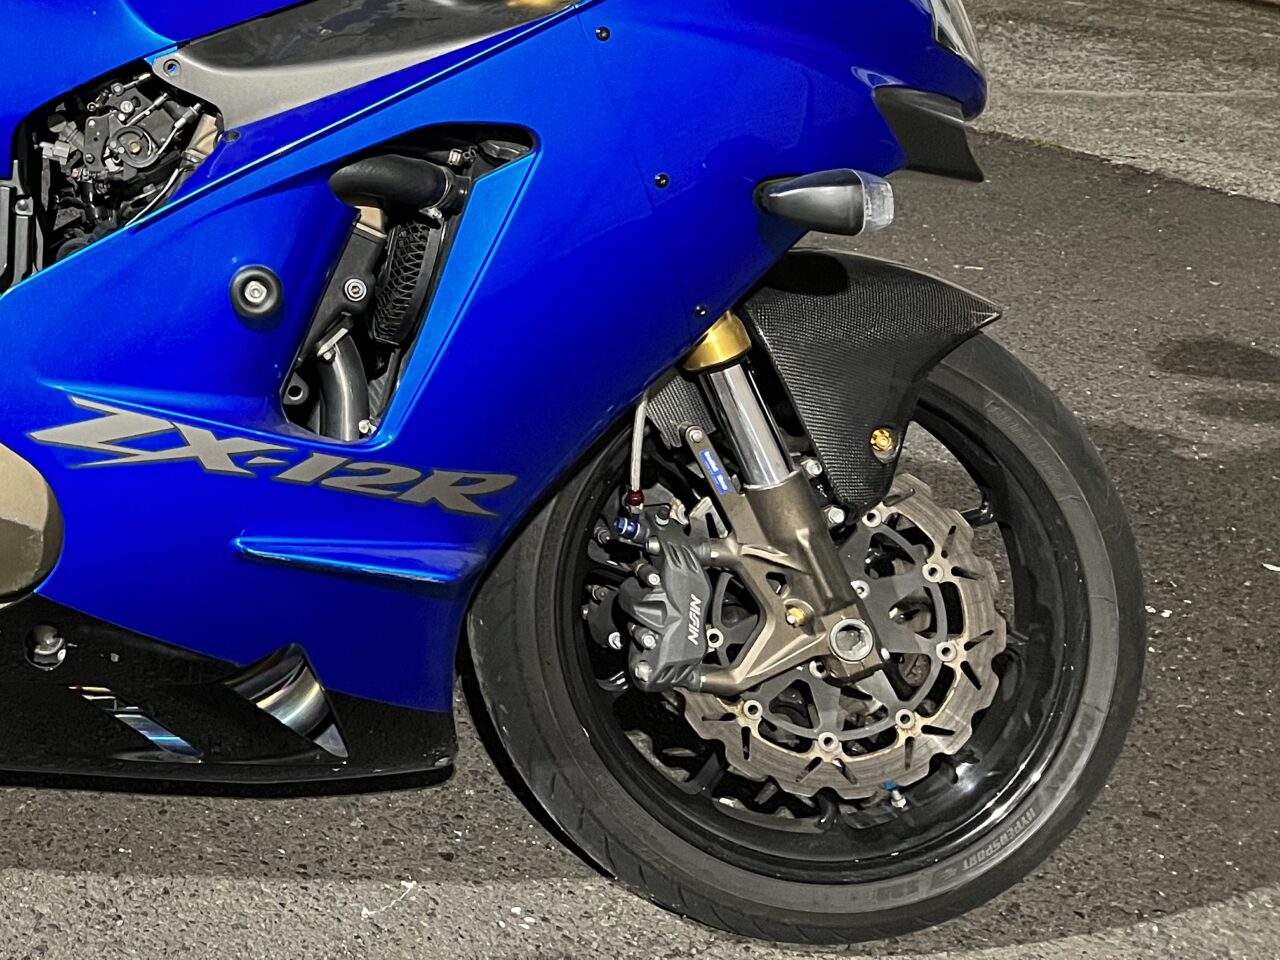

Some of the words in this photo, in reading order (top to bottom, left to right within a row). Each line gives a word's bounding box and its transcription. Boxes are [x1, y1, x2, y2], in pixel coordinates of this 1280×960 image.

[28, 395, 518, 517] ZX-12R
[687, 593, 702, 646] NISSIN
[962, 807, 1037, 870] HYPERSPORT
[11, 862, 213, 914] Kawasaki
